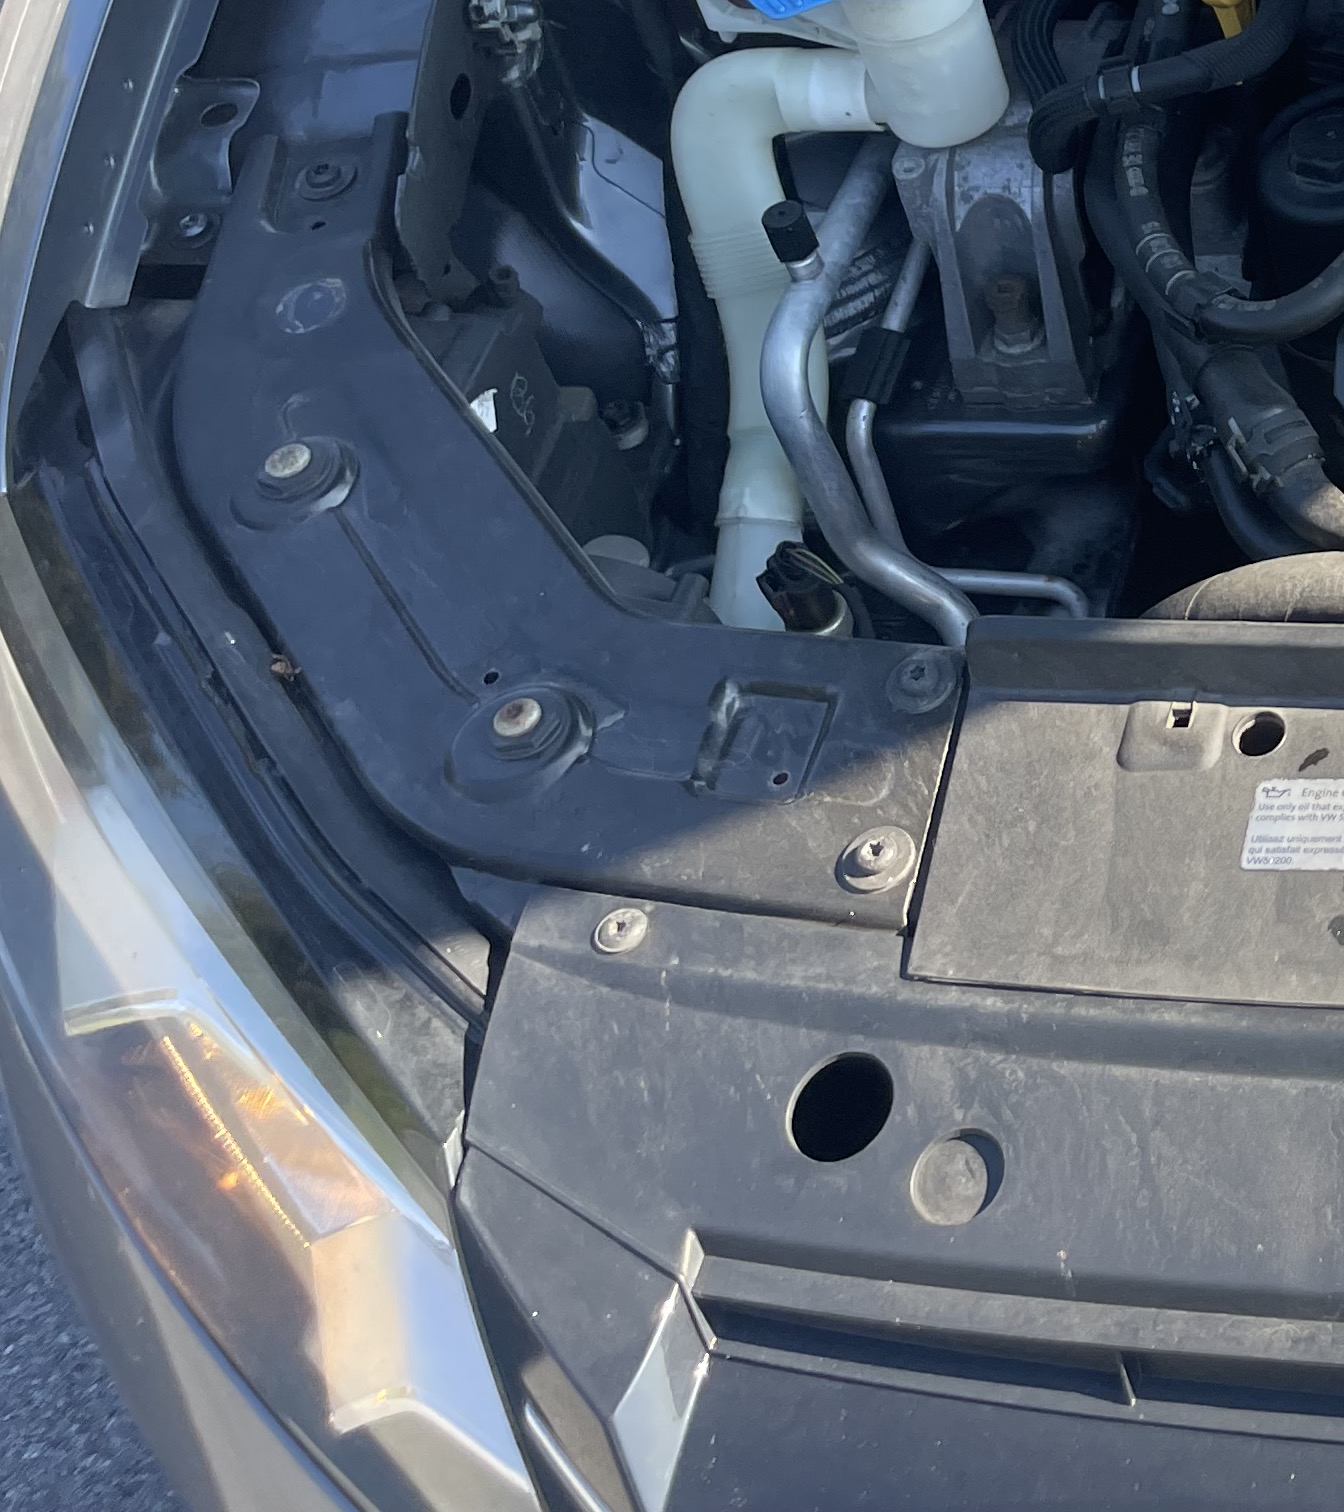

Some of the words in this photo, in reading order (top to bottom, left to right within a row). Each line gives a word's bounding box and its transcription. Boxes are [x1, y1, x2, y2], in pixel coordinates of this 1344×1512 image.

[1301, 788, 1339, 799] Engine
[1258, 803, 1275, 811] Use
[1276, 803, 1296, 813] only
[1298, 803, 1309, 811] oil
[1312, 803, 1330, 811] that
[1255, 814, 1296, 823] complies
[1251, 834, 1285, 843] Utilisez
[1286, 834, 1341, 845] uniquement
[1248, 846, 1263, 855] qui
[1265, 846, 1301, 854] satisfait
